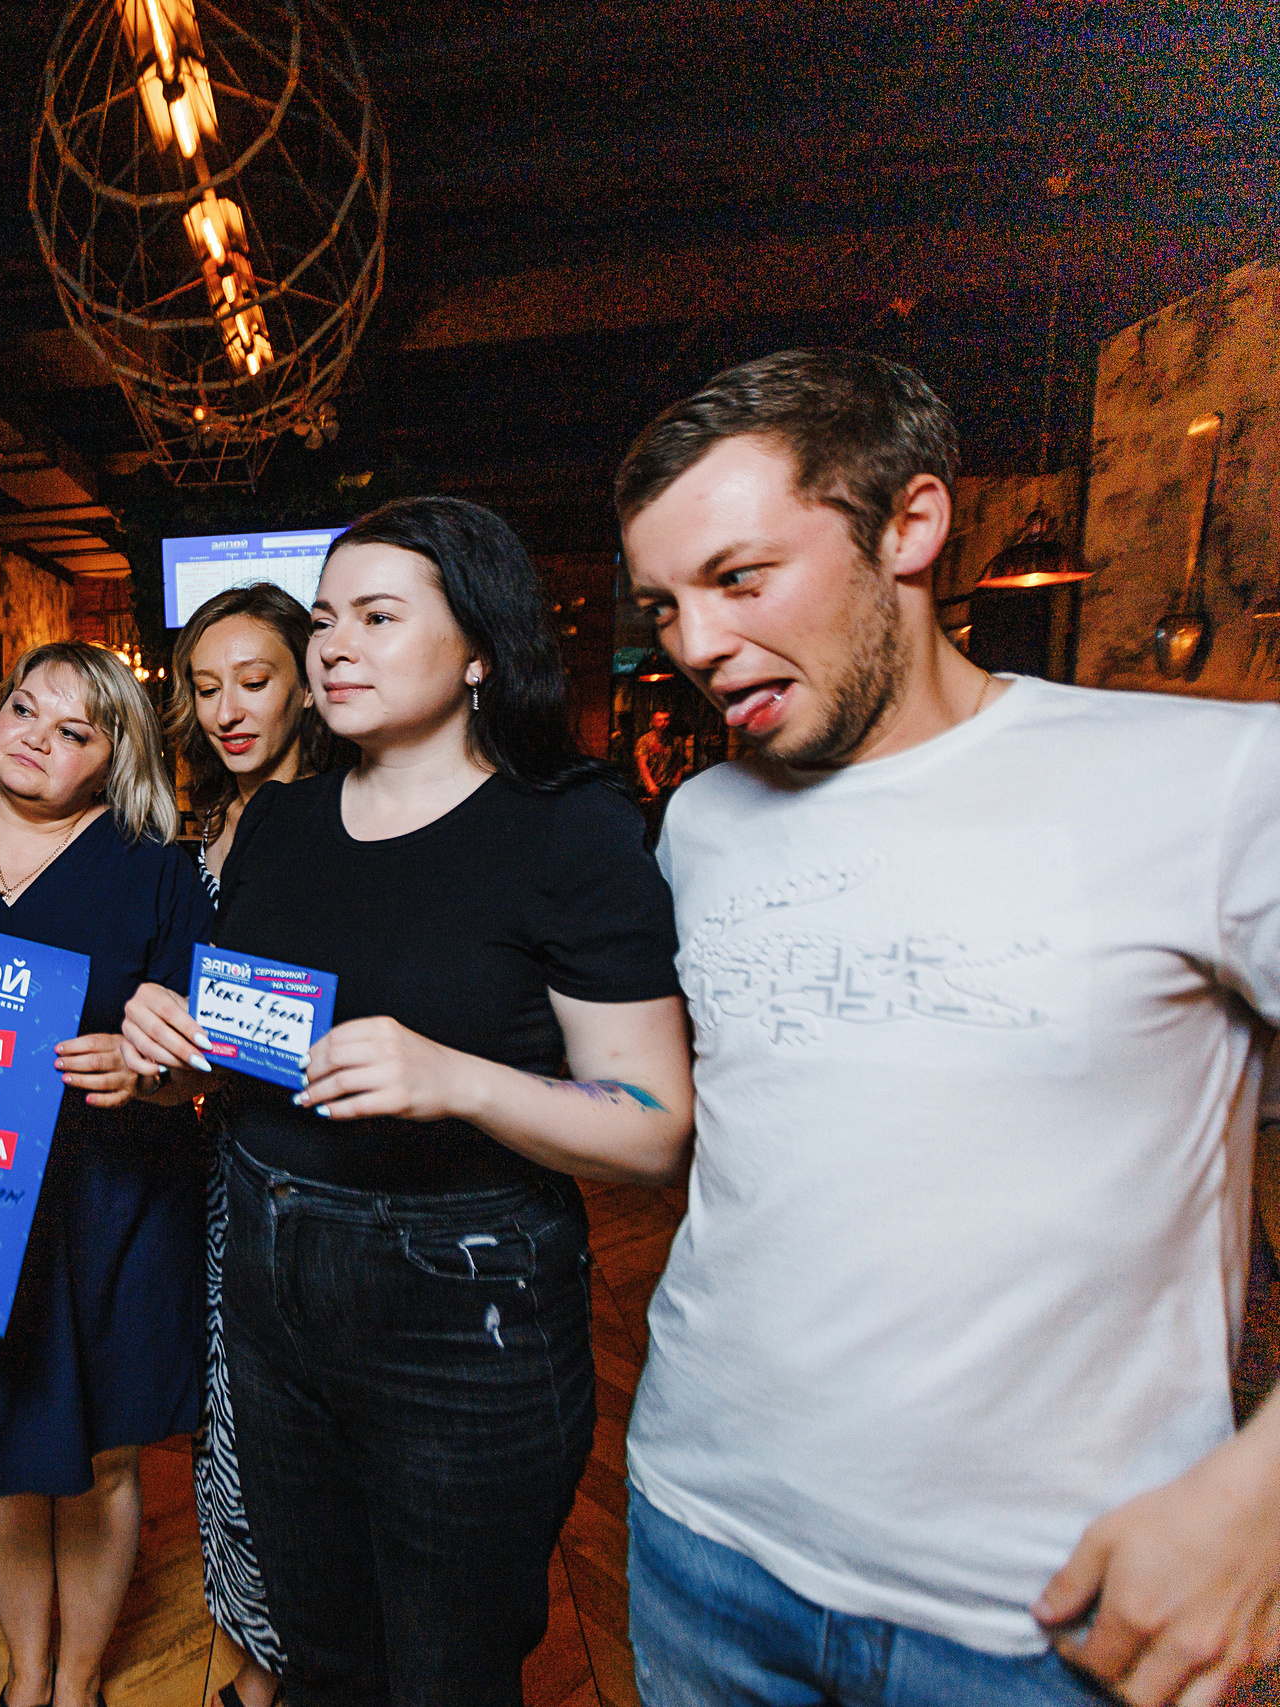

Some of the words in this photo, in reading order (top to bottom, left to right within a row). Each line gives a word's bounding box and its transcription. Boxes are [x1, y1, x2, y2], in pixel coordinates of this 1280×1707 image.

[202, 957, 251, 979] ЗАПОЙ
[255, 968, 307, 980] СЕРТИФИКАТ
[272, 981, 285, 990] НА
[285, 983, 319, 995] СКИДКУ
